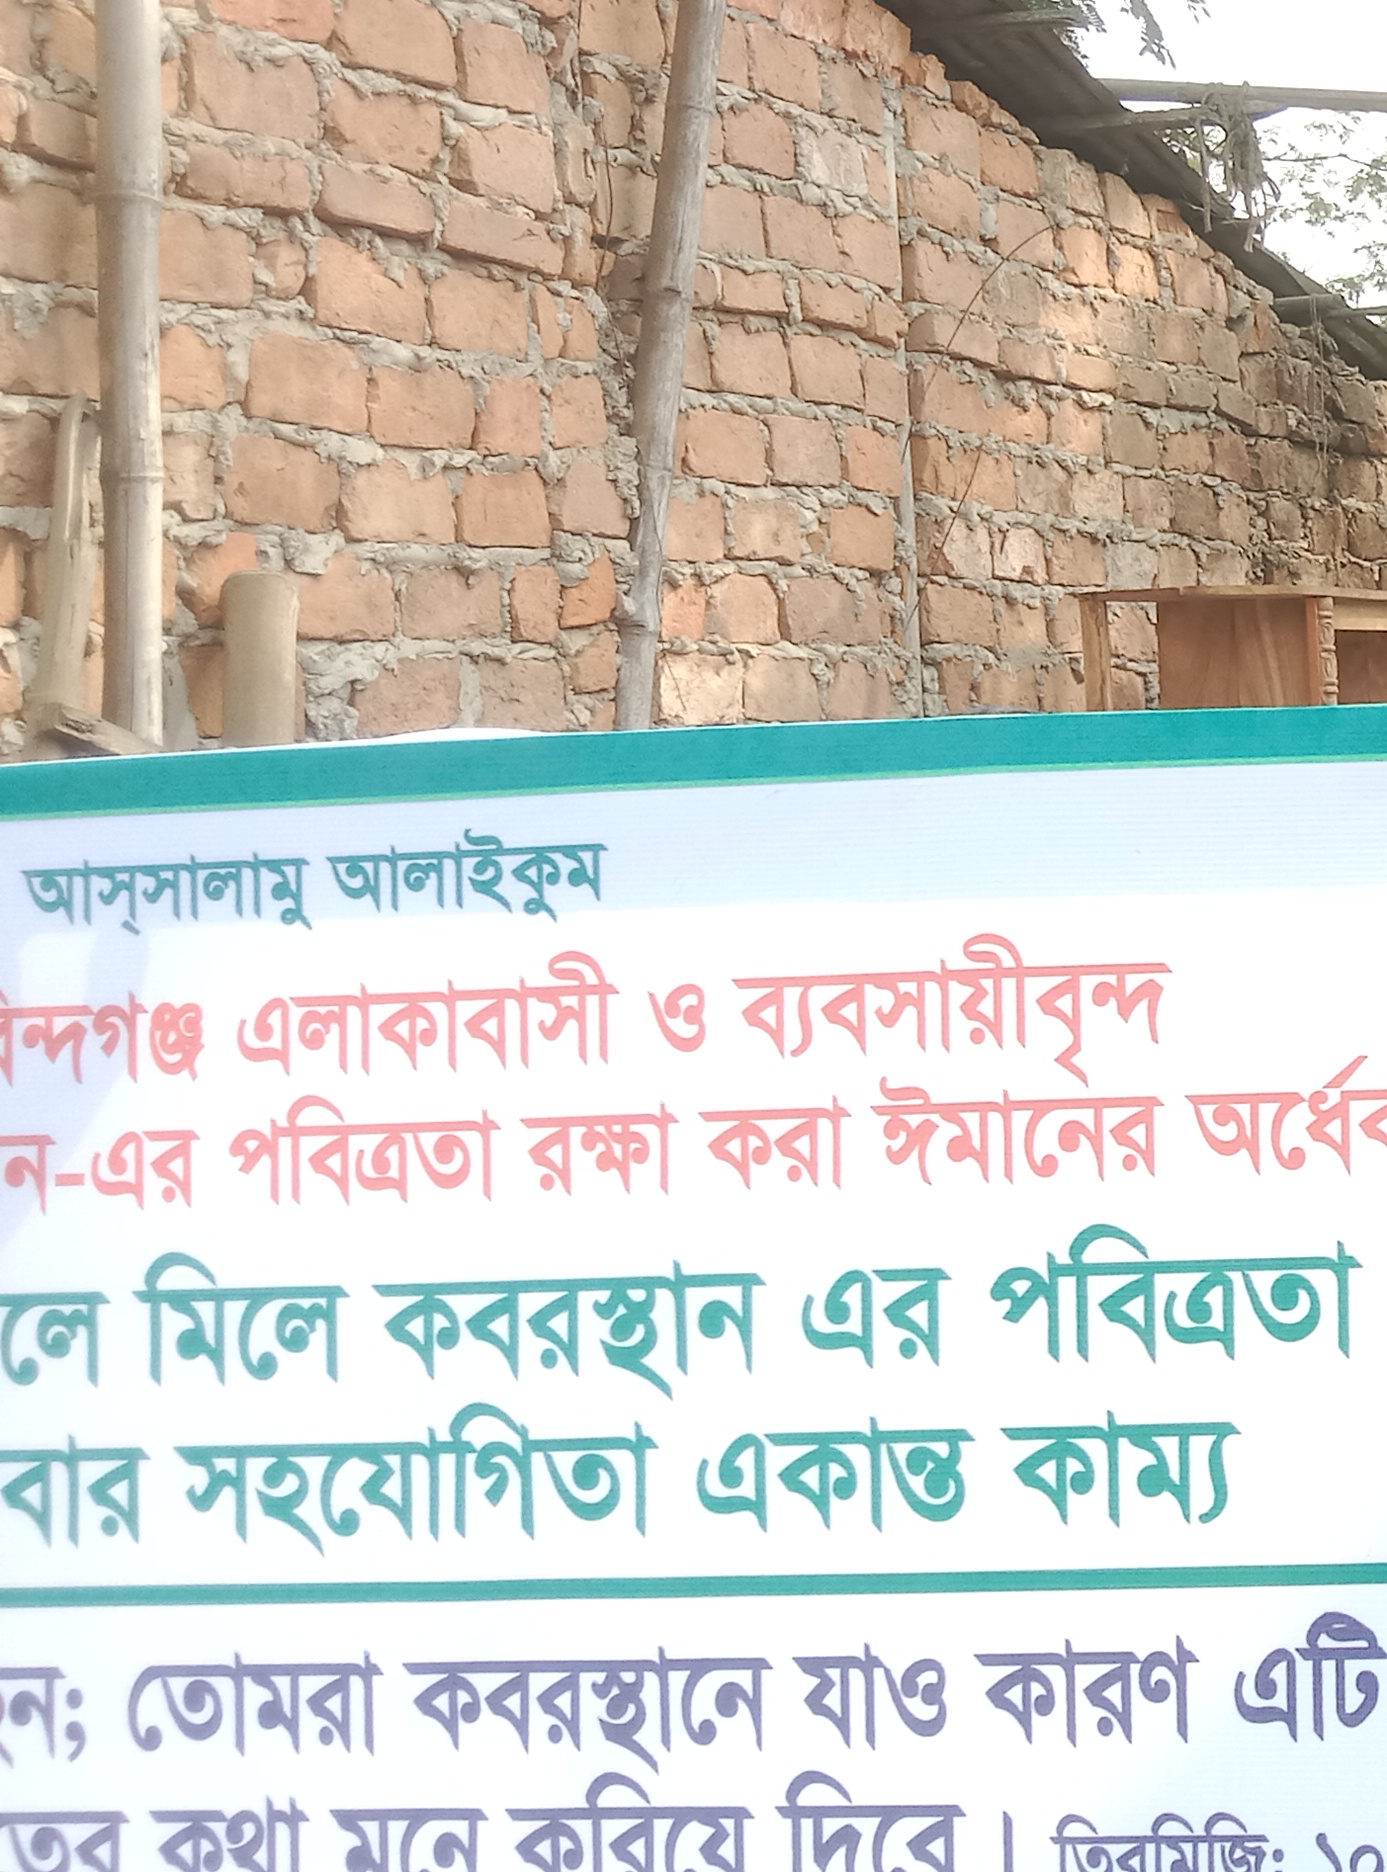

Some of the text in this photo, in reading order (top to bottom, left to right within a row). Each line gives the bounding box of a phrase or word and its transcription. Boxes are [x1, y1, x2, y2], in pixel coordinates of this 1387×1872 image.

[326, 828, 608, 922] আলাইকুম
[237, 951, 619, 1076] এলাকাবাসী
[648, 983, 706, 1052] ও
[732, 933, 1172, 1088] ব্যবসায়ীবৃন্দ
[229, 1095, 500, 1205] পবিত্রতা
[520, 1101, 679, 1196] রক্ষা
[699, 1096, 851, 1189] করা
[871, 1076, 1164, 1186] ঈমানের
[133, 1252, 350, 1386] মিলে
[372, 1261, 762, 1399] কবরস্থান
[802, 1268, 951, 1368] এর
[990, 1224, 1362, 1362] পবিত্রতা
[174, 1402, 658, 1556] সহযোগিতা
[697, 1417, 975, 1532] একান্ত
[1000, 1410, 1241, 1527] কাম্য
[128, 1651, 384, 1756] তোমরা
[403, 1647, 773, 1774] কবরস্থানে
[792, 1643, 947, 1751] যাও
[973, 1635, 1200, 1748] কারণ
